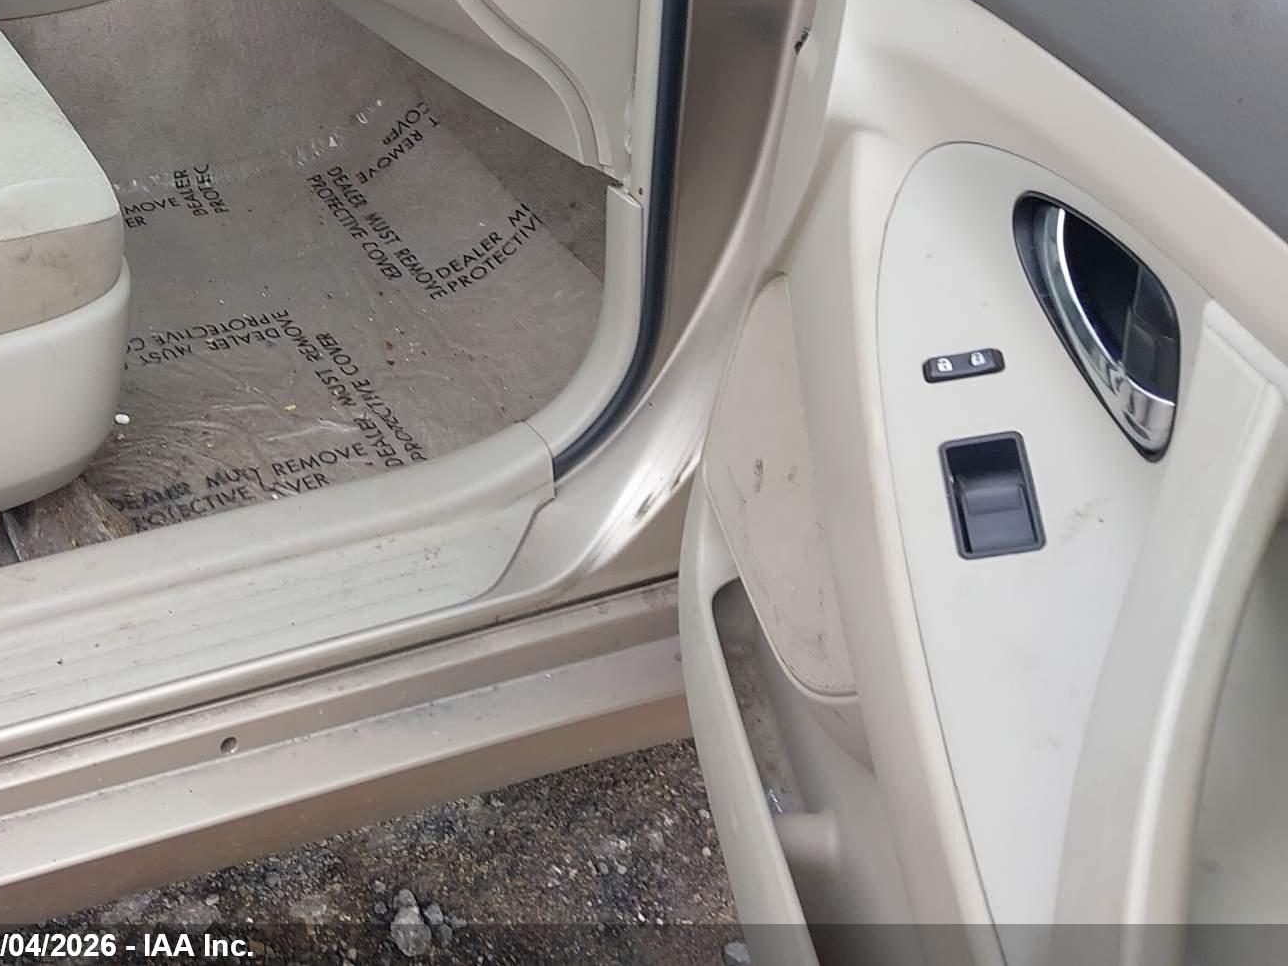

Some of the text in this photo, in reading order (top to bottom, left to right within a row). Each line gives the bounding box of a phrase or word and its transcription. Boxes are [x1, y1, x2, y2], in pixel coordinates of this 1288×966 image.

[382, 101, 430, 146] COVER
[355, 129, 424, 184] REMOVE
[173, 169, 209, 217] DEALER
[306, 173, 403, 282] PROTECTIVE COVER
[327, 166, 448, 301] DEALER MUST REMOVE
[435, 231, 503, 280] DEALER
[151, 312, 273, 346] PROTECTIVE
[206, 326, 281, 351] DEALER
[138, 344, 193, 366] MUST
[271, 309, 405, 468] DEALER MUST REMOVE
[315, 332, 428, 462] PROTECTIVE COVER
[271, 441, 368, 477] REMOVE
